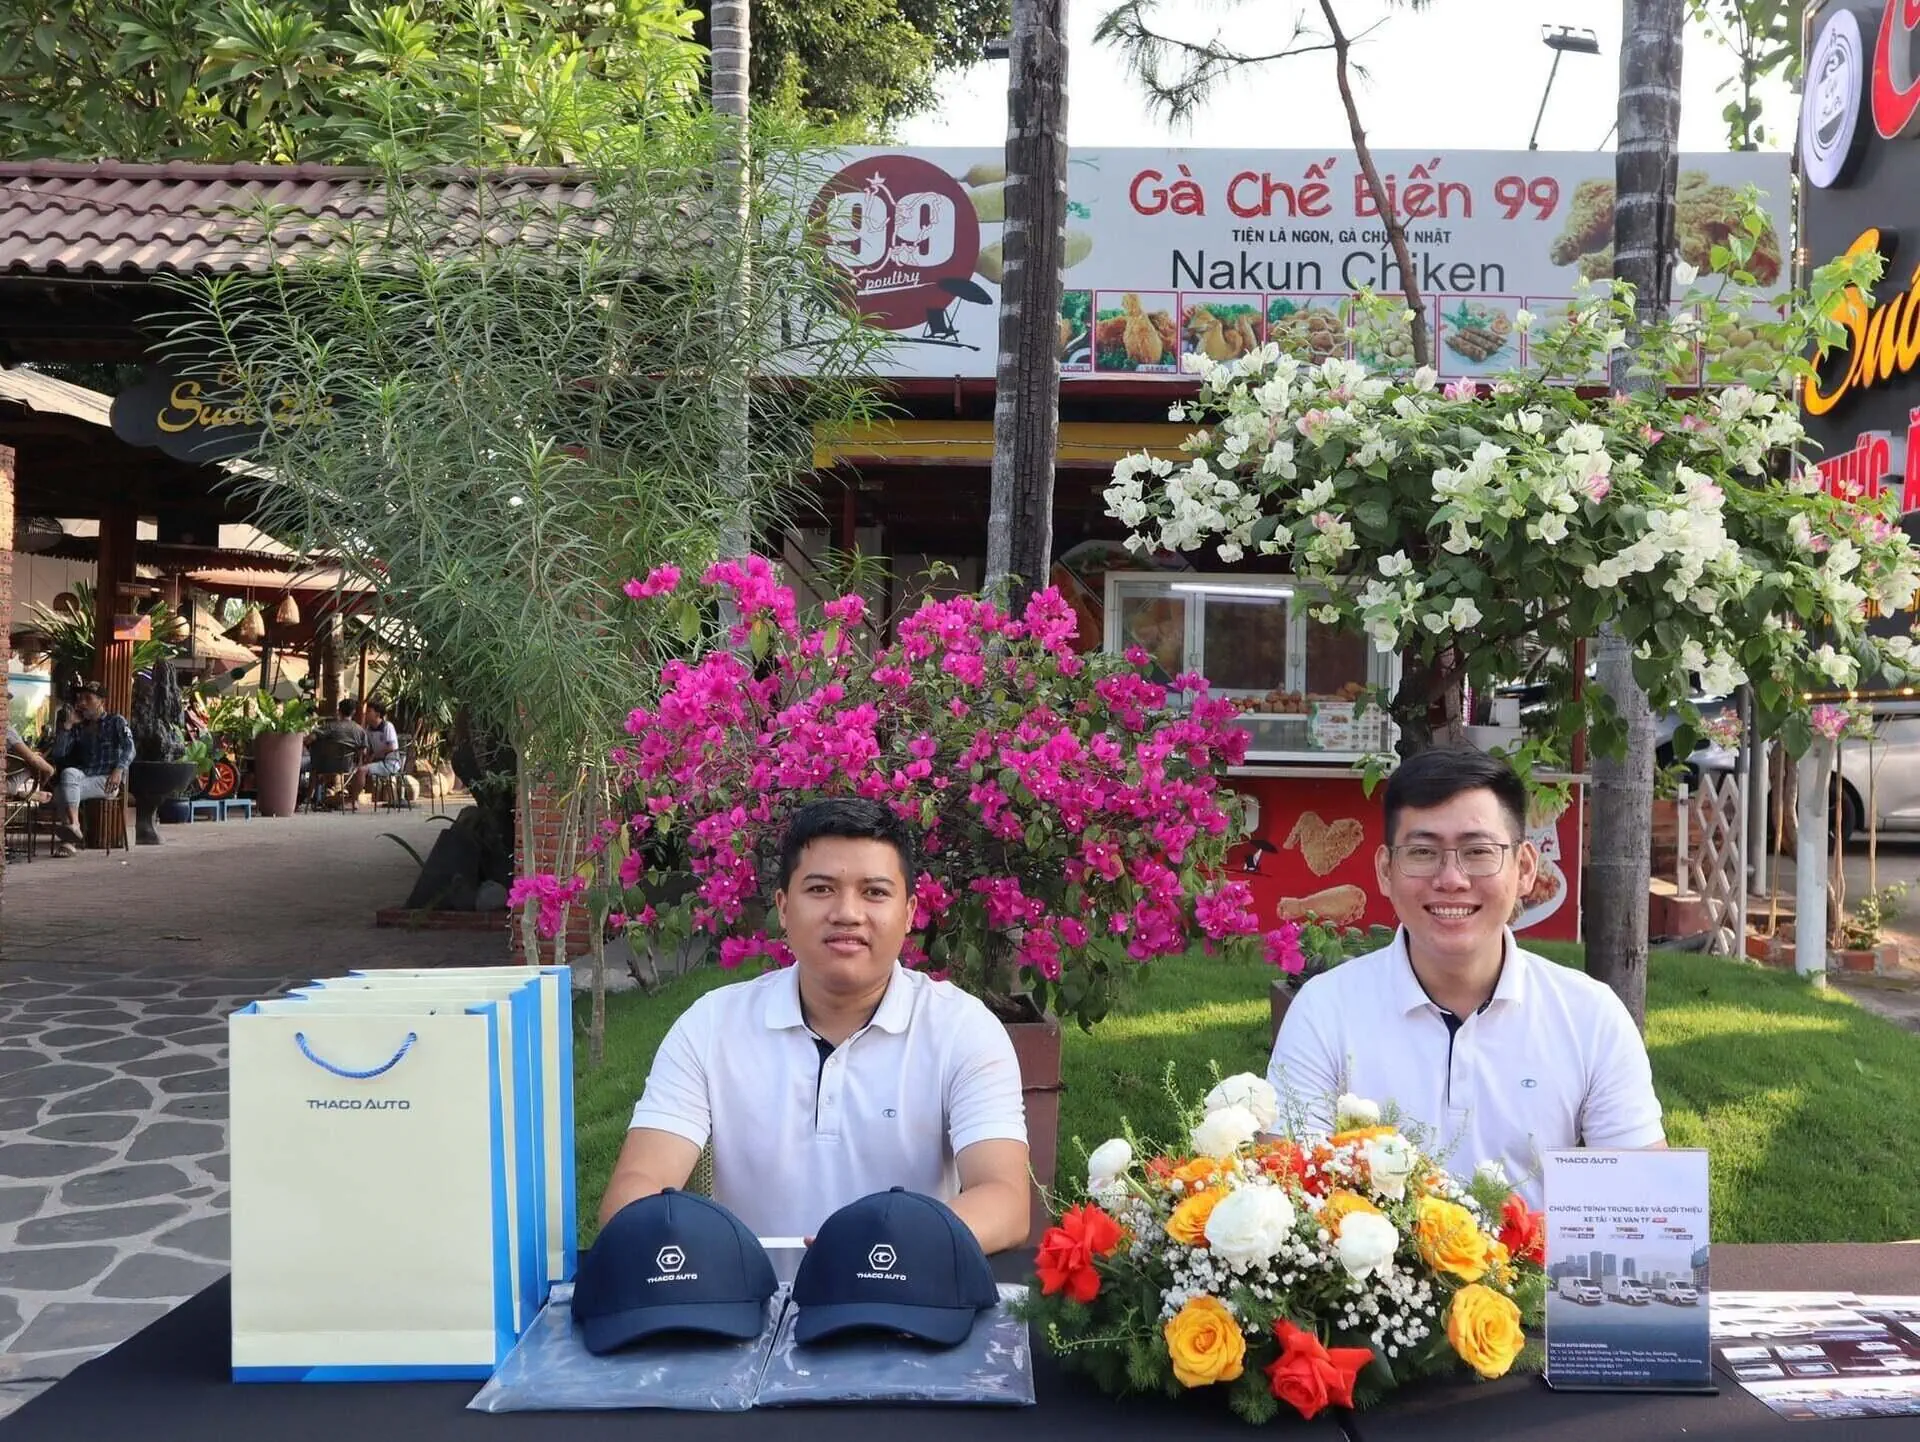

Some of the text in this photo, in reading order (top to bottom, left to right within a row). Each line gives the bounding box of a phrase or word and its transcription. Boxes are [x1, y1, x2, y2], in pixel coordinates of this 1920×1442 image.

[1129, 157, 1560, 220] Gà Chế Biến 99
[825, 191, 956, 267] 99
[1232, 227, 1453, 245] TIỆN LÀ NGON, GÀ CHUN NHẬT
[1171, 249, 1505, 293] Nakun Chiken
[864, 271, 921, 291] poultry
[306, 1098, 410, 1110] THACO AUTO
[1555, 1156, 1618, 1165] THACO AUTO
[646, 1273, 698, 1284] THACO AUTO
[856, 1272, 907, 1281] THACO AUTO
